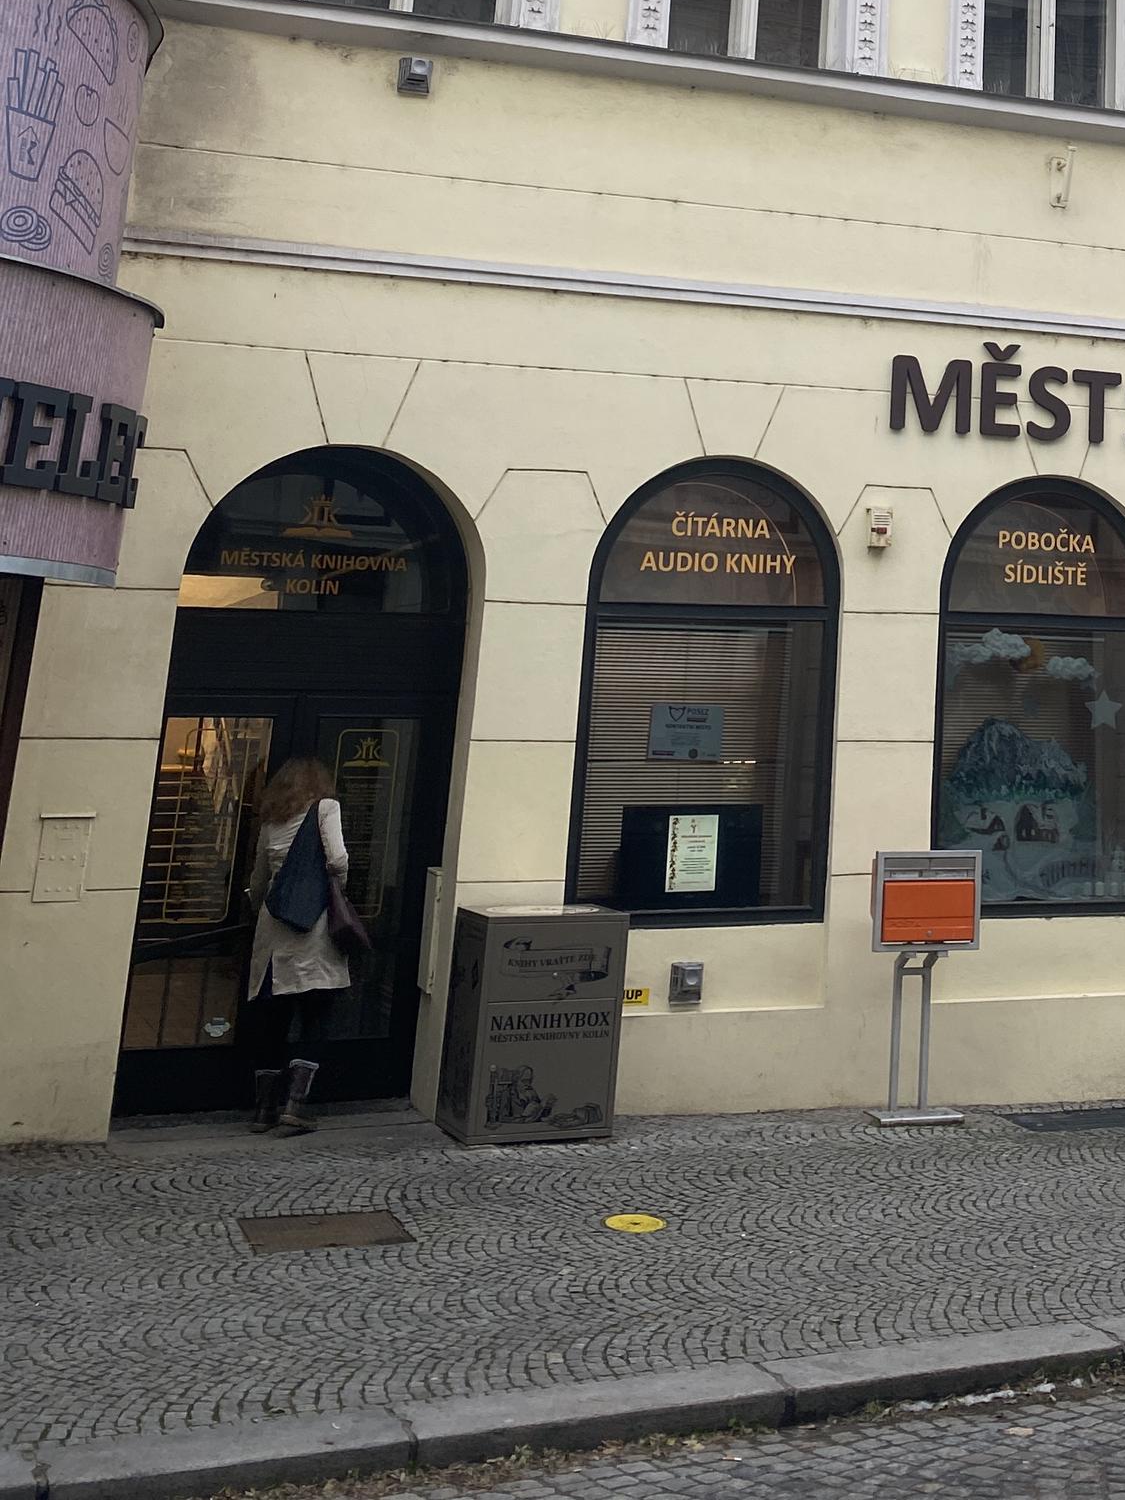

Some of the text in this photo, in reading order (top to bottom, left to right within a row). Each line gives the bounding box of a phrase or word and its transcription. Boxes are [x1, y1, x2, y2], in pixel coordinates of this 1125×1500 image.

[671, 511, 771, 539] ČÍTÁRNA
[998, 528, 1095, 554] POBOČKA
[220, 548, 408, 573] MĚSTSKÁ KNIHOVNA
[640, 551, 796, 575] AUDIO KNIHY
[1004, 559, 1087, 587] SÍDLIŠTĚ
[285, 577, 340, 596] KOLÍN
[507, 957, 538, 967] KNIHY
[490, 1011, 611, 1031] NAKNIHYBOX
[533, 1031, 581, 1041] KNIHOVNY
